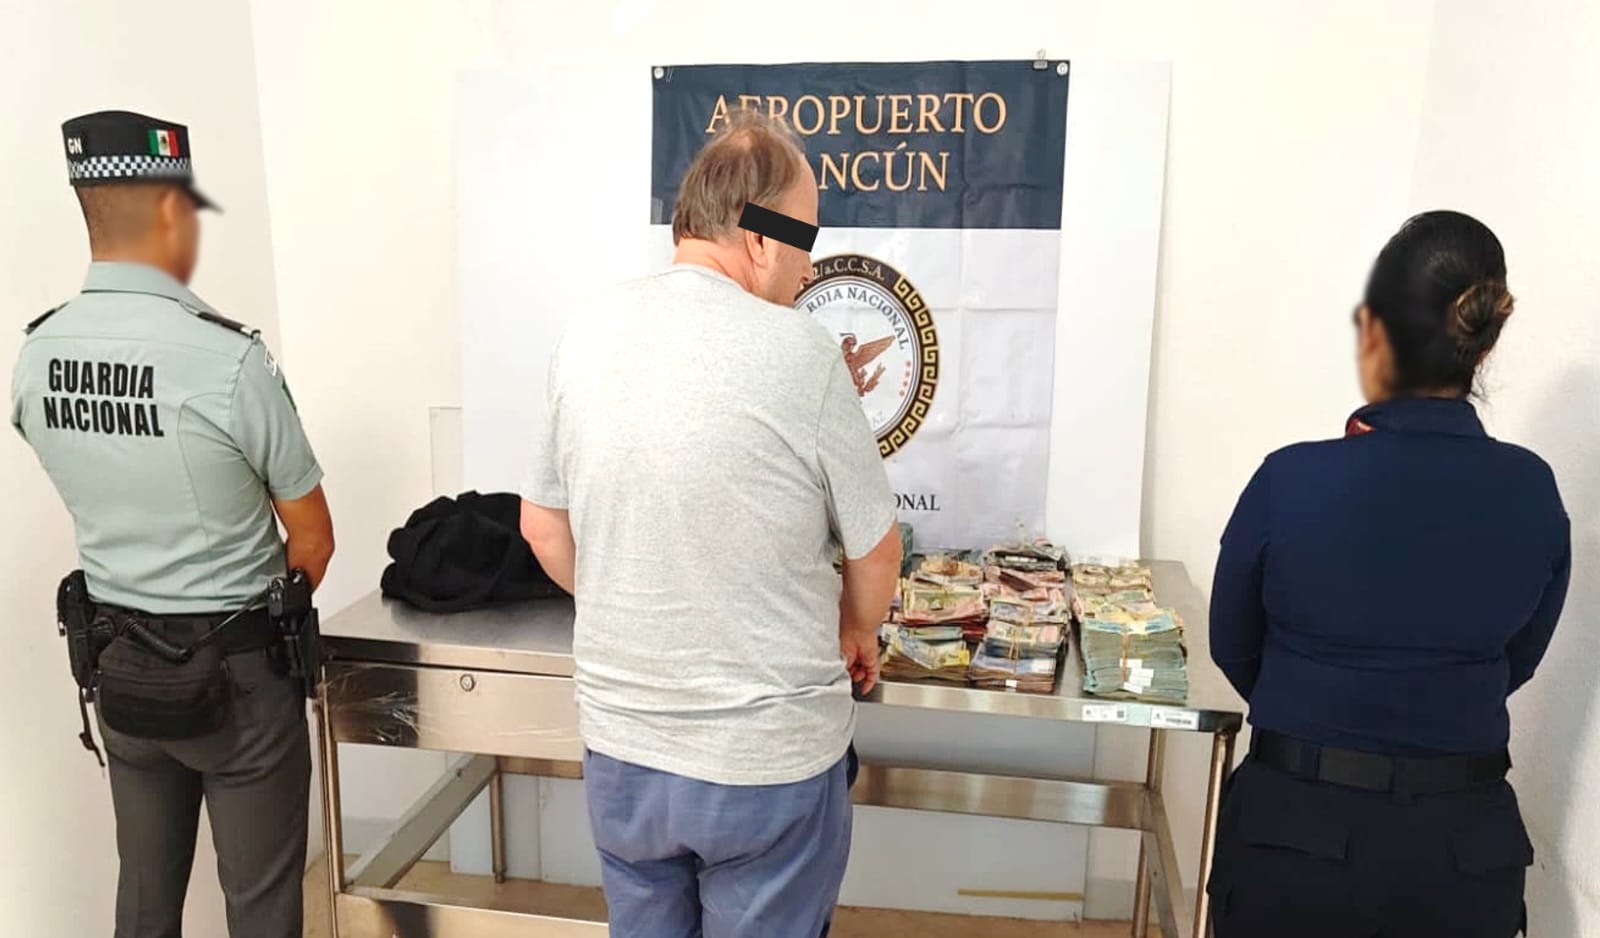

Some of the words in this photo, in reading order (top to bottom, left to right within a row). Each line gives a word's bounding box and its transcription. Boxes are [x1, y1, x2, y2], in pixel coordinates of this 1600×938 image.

[67, 137, 83, 154] GN
[818, 141, 951, 192] NCÚN
[806, 287, 843, 313] RDIA
[847, 286, 909, 350] NACIONAL
[48, 357, 155, 400] GUARDIA
[42, 396, 165, 438] NACIONAL
